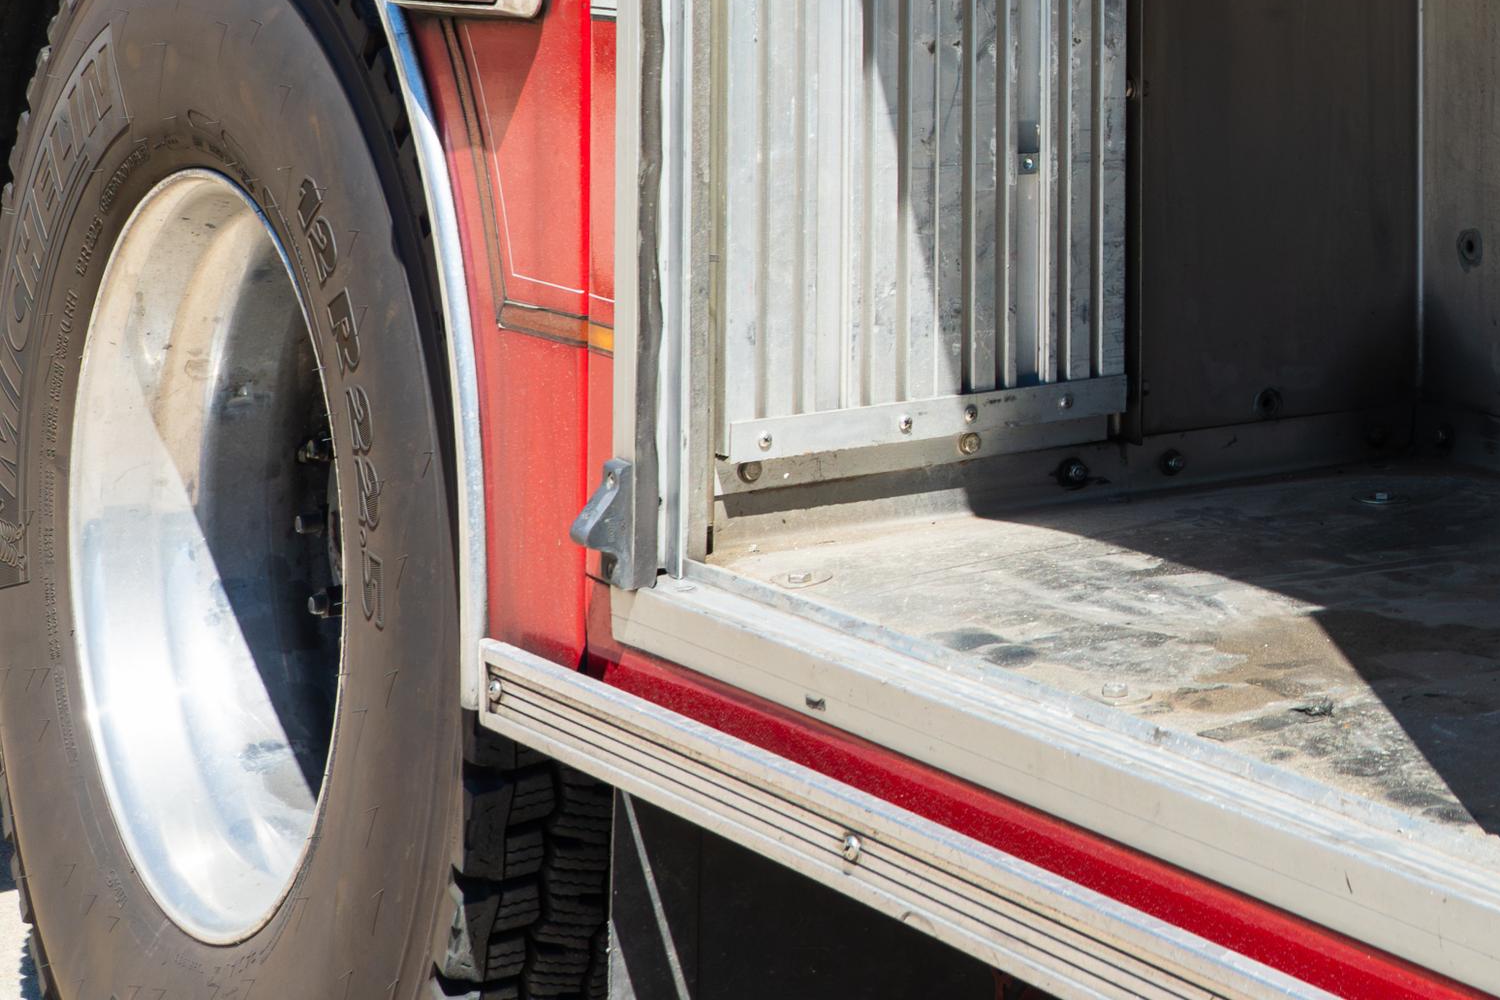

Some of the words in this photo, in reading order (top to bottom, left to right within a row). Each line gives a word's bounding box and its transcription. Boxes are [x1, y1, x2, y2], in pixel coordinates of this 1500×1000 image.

[0, 42, 113, 500] MICHELIN
[298, 174, 337, 288] 12
[327, 286, 361, 378] R
[346, 383, 385, 632] 22.5
